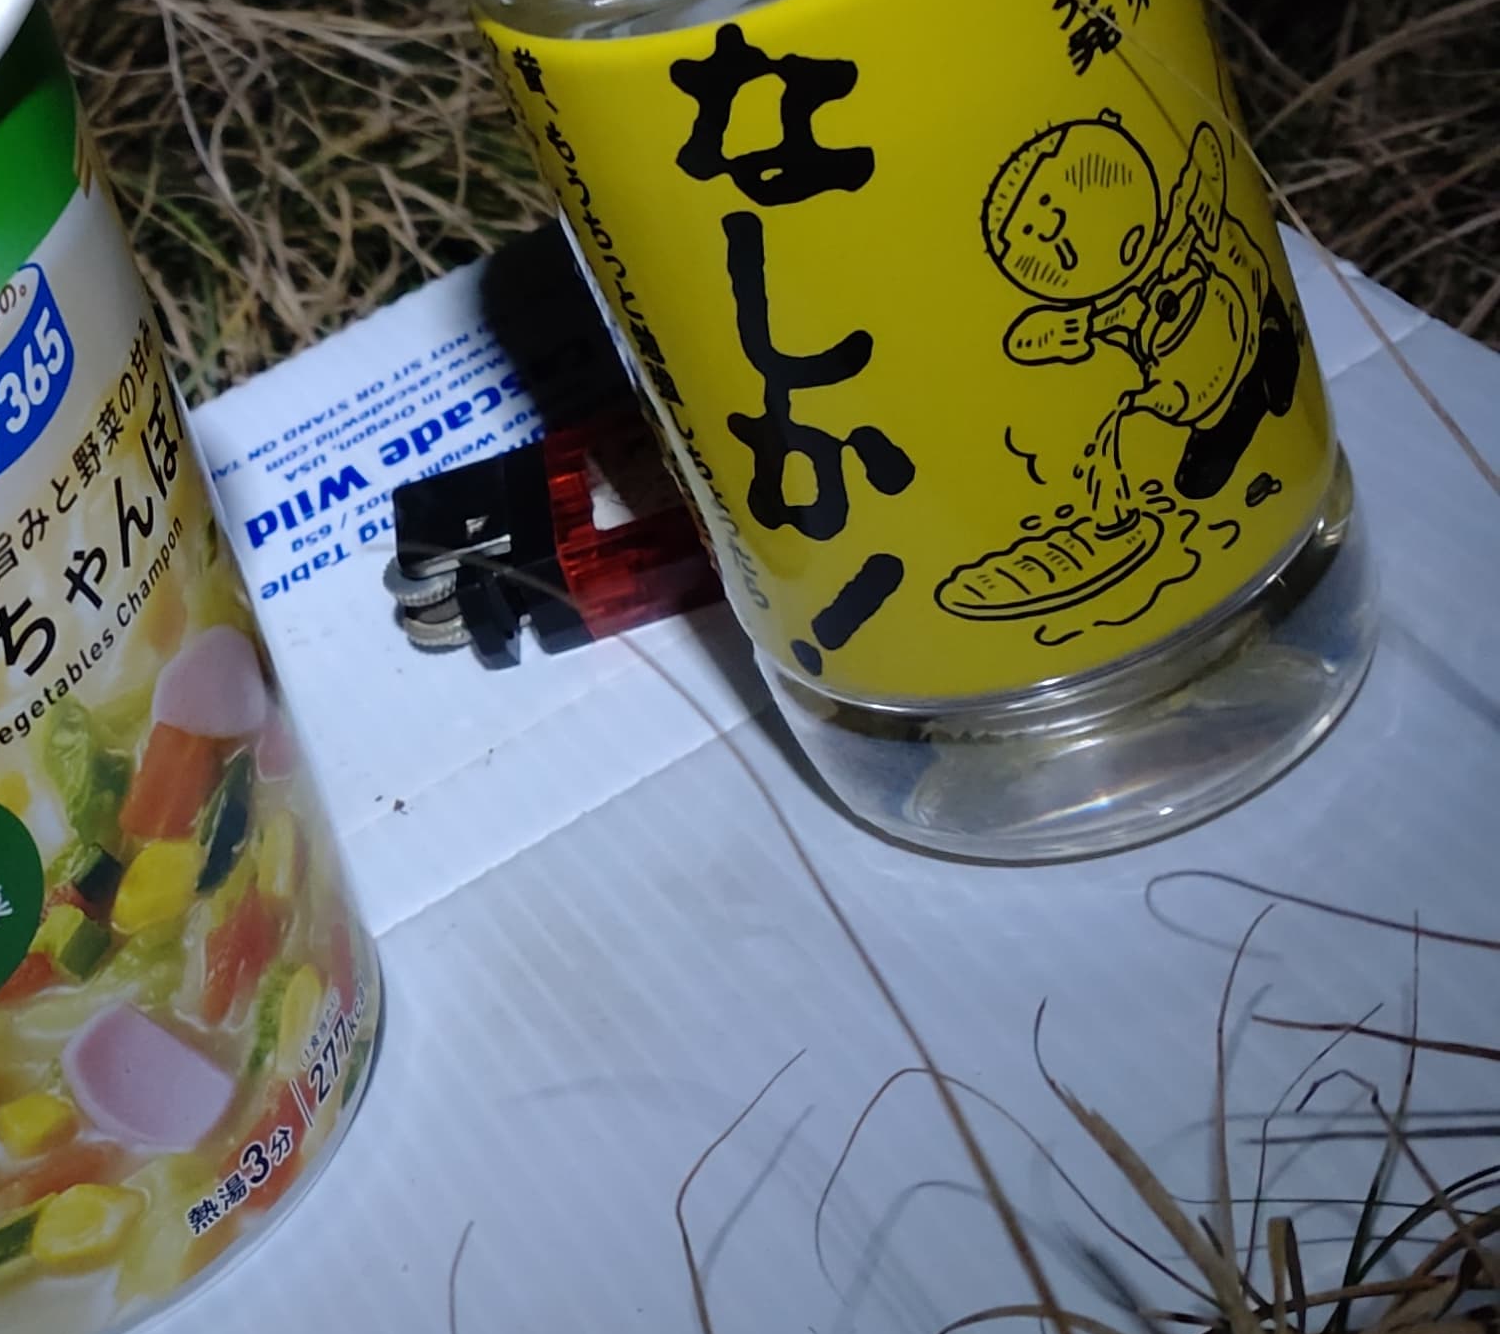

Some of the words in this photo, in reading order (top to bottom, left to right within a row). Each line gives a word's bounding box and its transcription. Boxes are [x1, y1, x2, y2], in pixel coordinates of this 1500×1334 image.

[450, 352, 508, 388] Made
[357, 382, 384, 401] OR
[422, 390, 441, 404] in
[284, 403, 348, 441] STAND
[249, 442, 276, 460] ON
[285, 455, 326, 481] USA
[245, 466, 369, 548] Wild
[292, 525, 332, 552] 65g
[115, 516, 184, 629] Champon
[262, 544, 349, 599] Table
[187, 1128, 292, 1234] 熱湯3分
